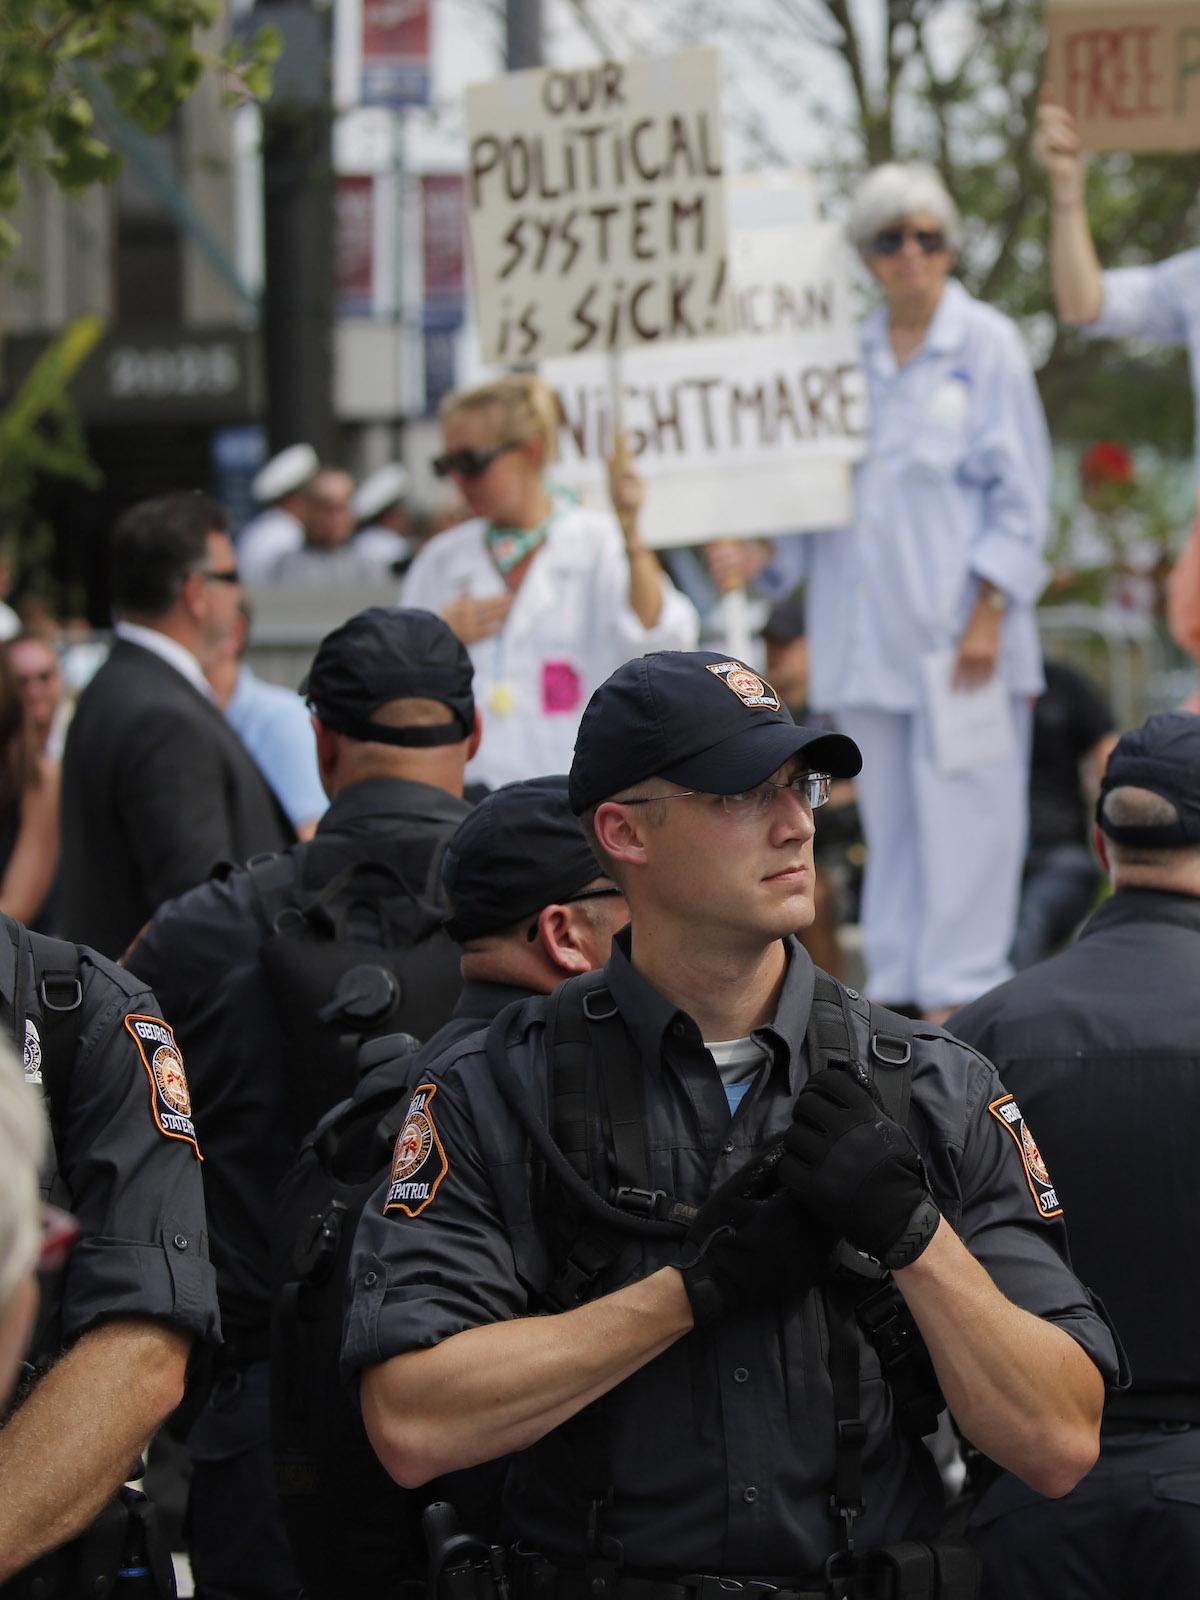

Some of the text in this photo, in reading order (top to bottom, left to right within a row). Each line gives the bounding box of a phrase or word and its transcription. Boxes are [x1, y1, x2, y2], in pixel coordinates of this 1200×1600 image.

[545, 62, 626, 115] OUR
[1064, 25, 1163, 119] FREE
[498, 196, 704, 280] SYSTEM
[737, 282, 834, 332] ICAN
[160, 1113, 190, 1135] STATE
[393, 1183, 430, 1200] PATROL
[1040, 1189, 1060, 1211] STAT
